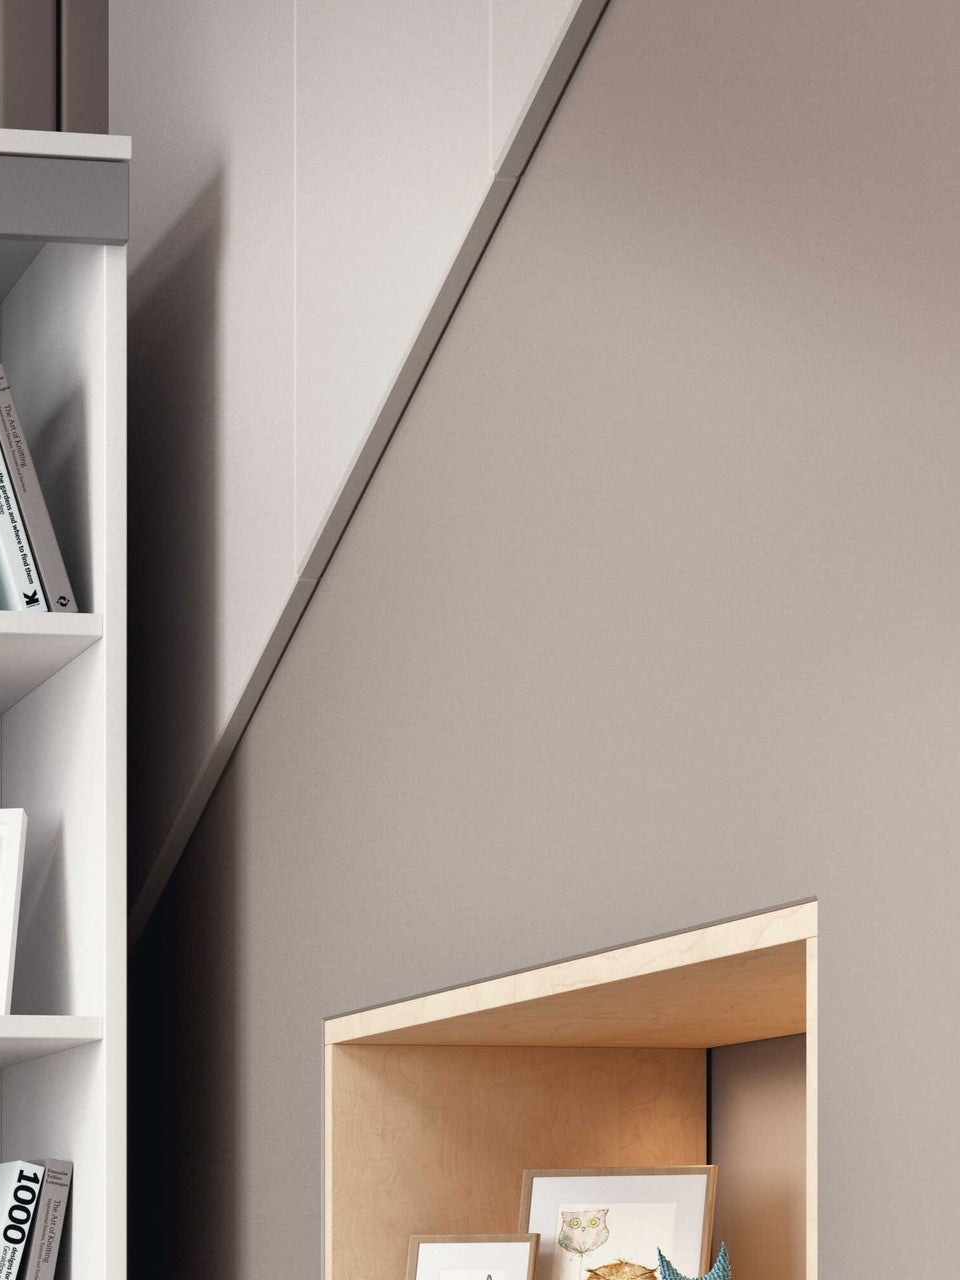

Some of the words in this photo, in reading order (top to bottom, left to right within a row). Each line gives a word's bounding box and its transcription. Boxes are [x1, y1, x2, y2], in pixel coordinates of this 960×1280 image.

[4, 404, 14, 418] The
[8, 419, 17, 430] Art
[12, 431, 20, 439] of
[14, 439, 28, 468] Knitting
[0, 484, 13, 511] gardens
[8, 511, 17, 524] and
[12, 524, 23, 545] where
[18, 545, 25, 553] to
[21, 553, 30, 567] find
[25, 567, 35, 585] them
[3, 1169, 40, 1245] 1000
[53, 1199, 62, 1213] The
[49, 1226, 56, 1235] of
[7, 1247, 18, 1271] designs
